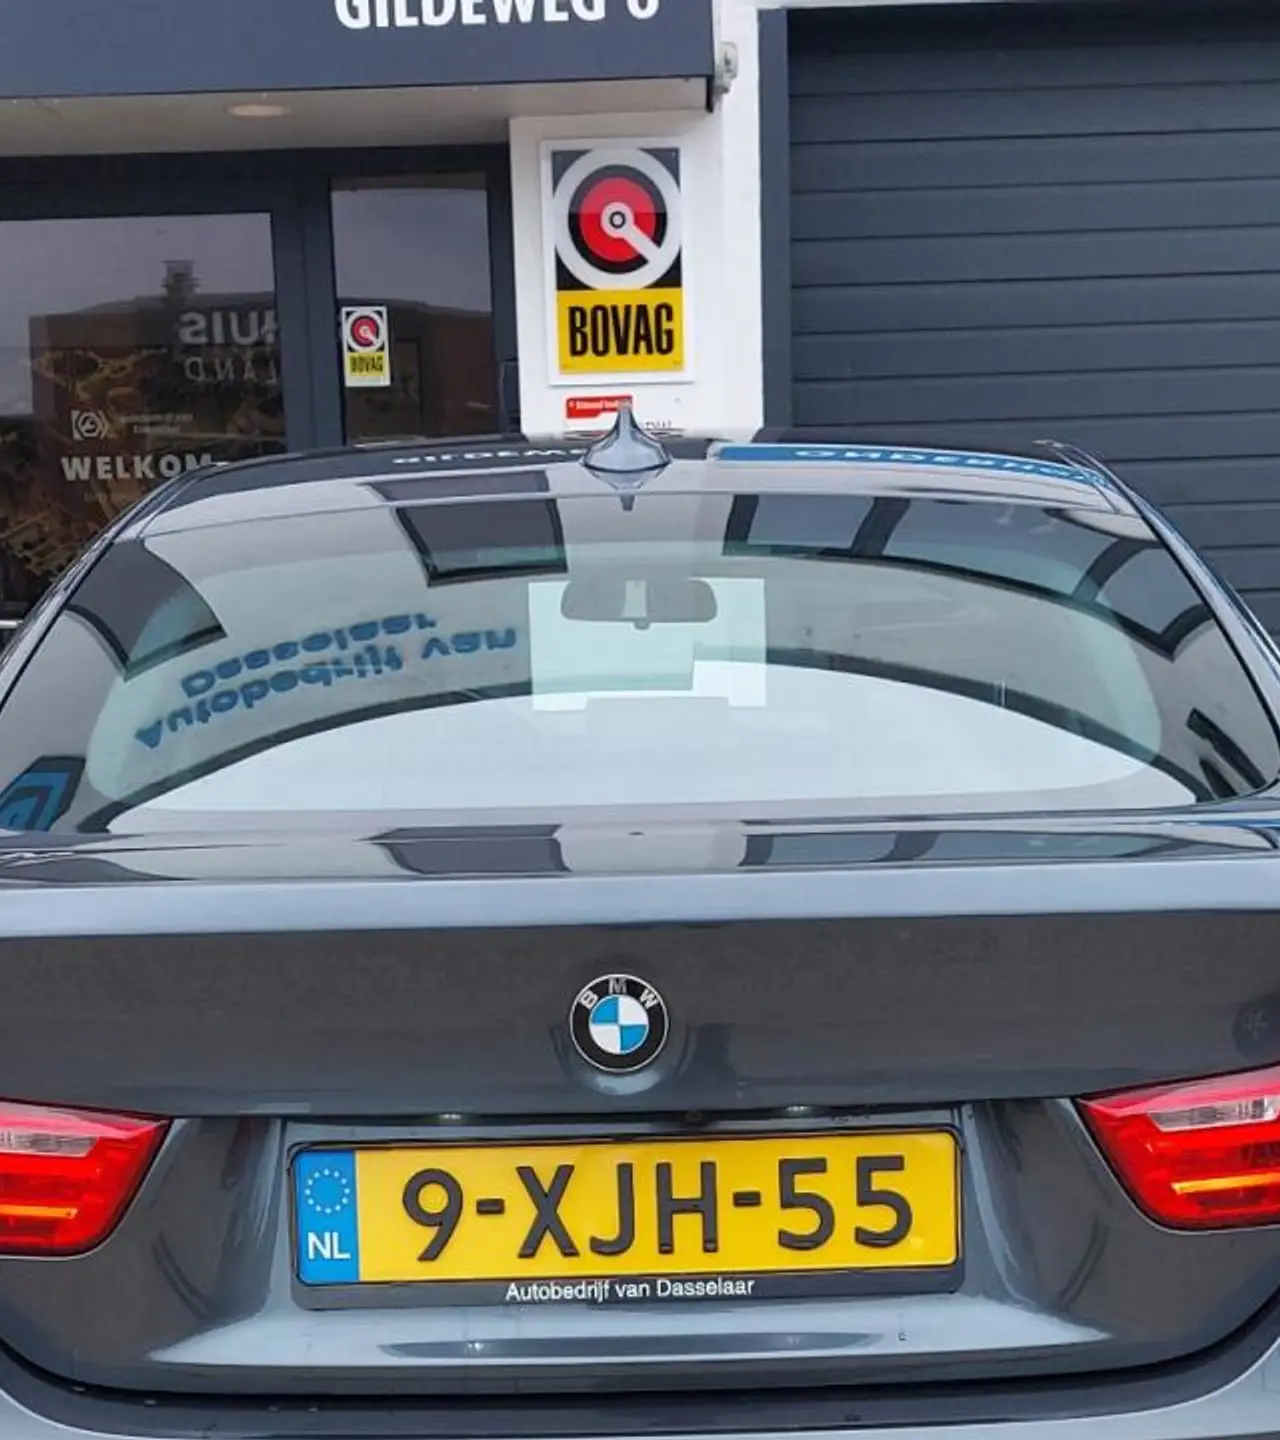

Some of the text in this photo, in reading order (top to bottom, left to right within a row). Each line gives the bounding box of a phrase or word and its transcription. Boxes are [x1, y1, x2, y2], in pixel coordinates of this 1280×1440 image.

[335, 0, 606, 29] GILDEWEG
[568, 302, 674, 358] BOVAG
[349, 353, 384, 373] BOVAG
[60, 453, 213, 482] WELKOM
[401, 1154, 914, 1262] 9-XJH-55
[307, 1231, 351, 1261] NL
[505, 1276, 756, 1303] Autobedrijf van Dasselaar
